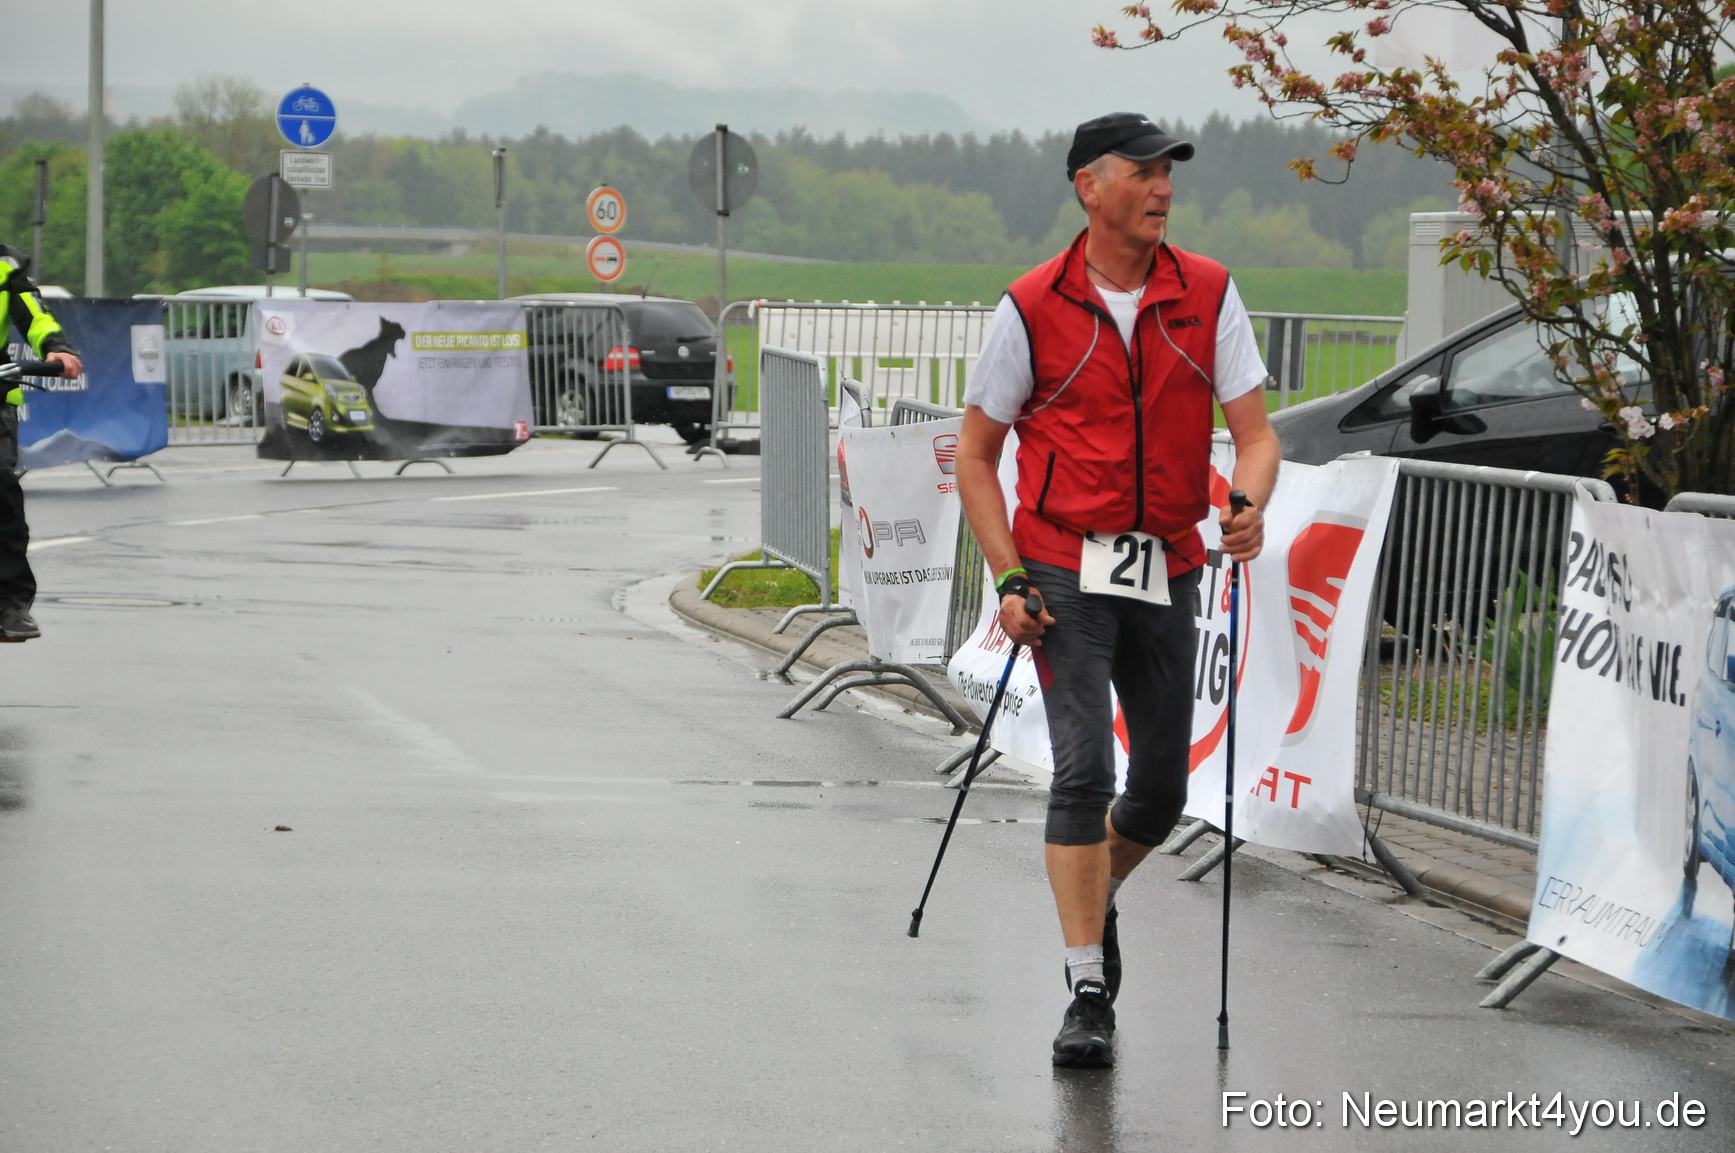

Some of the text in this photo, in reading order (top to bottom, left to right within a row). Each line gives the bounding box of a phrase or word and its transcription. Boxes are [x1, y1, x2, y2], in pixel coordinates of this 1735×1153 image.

[596, 200, 616, 220] 60
[415, 335, 431, 348] DER
[434, 335, 455, 348] NEUE
[457, 334, 488, 348] PICANTO
[490, 334, 501, 347] IST
[857, 506, 926, 559] OPA
[900, 570, 915, 585] IST
[915, 567, 931, 583] DAS
[1110, 534, 1154, 592] 21
[1250, 766, 1312, 810] AT
